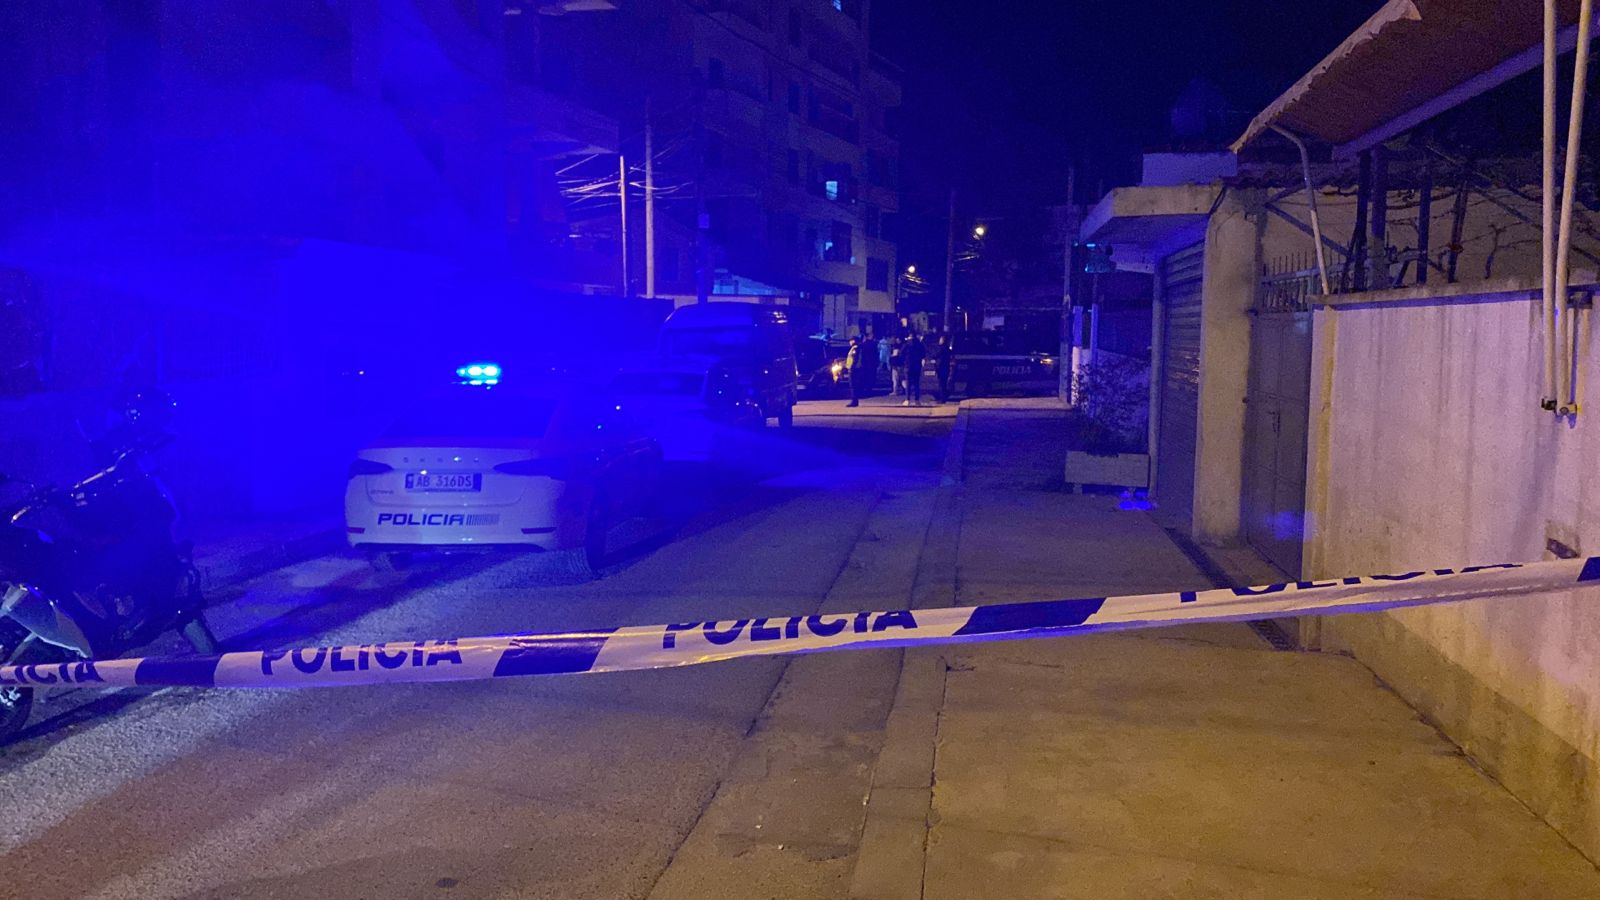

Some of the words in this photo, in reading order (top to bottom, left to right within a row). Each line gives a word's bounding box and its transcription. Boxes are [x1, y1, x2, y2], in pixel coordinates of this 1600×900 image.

[416, 475, 431, 487] AB
[436, 475, 472, 488] 316DS
[377, 513, 465, 526] POLICIA
